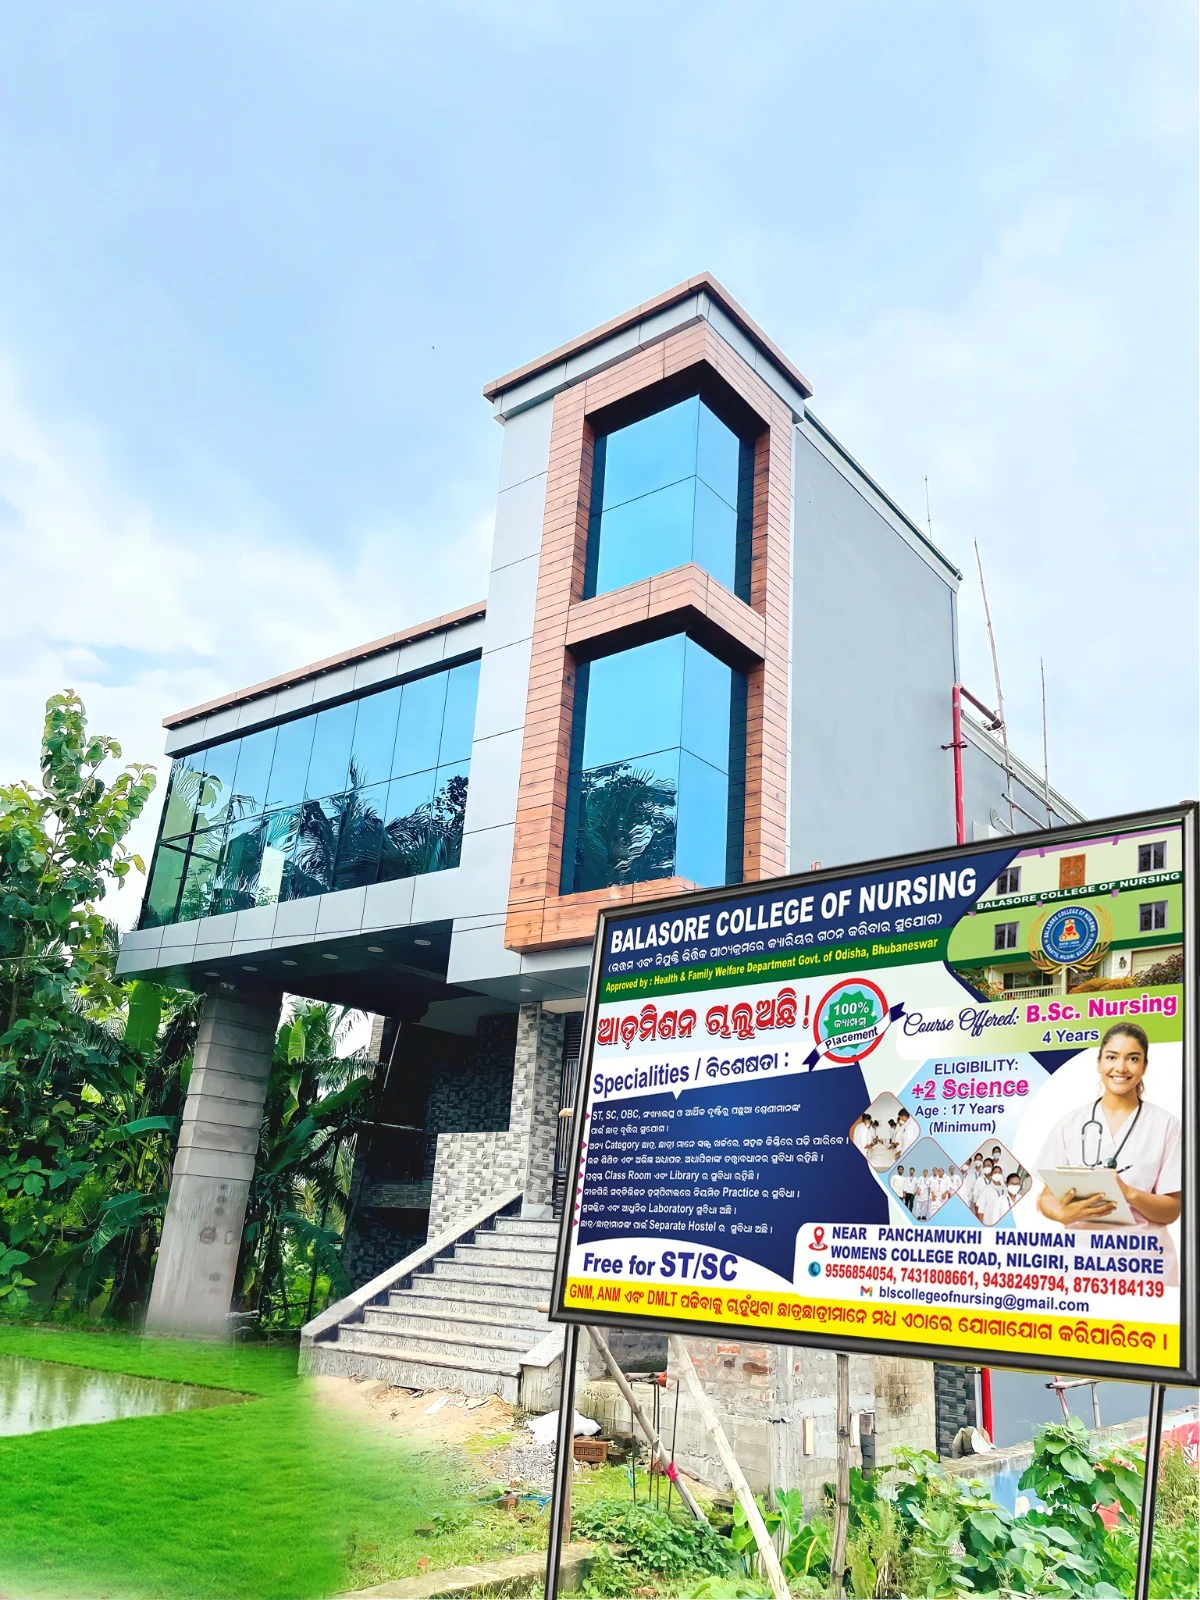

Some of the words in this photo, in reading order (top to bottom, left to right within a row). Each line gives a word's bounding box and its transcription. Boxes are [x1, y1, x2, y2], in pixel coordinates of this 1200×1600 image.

[976, 894, 1036, 910] BALASORE
[1040, 885, 1095, 900] COLLEGE
[1100, 882, 1116, 891] OF
[1119, 872, 1180, 888] NURSING
[611, 914, 710, 954] BALASORE
[716, 896, 814, 937] COLLEGE
[821, 889, 852, 919] OF
[859, 867, 976, 914] NURSING
[606, 977, 638, 993] Approved
[639, 976, 648, 990] by
[654, 972, 678, 985] Health
[680, 971, 686, 982] &
[687, 968, 713, 981] Family
[715, 962, 745, 977] Welfare
[746, 958, 796, 974] Department
[798, 954, 821, 965] Govt.
[823, 951, 833, 962] of
[835, 947, 870, 962] Odisha,
[872, 938, 939, 956] Bhubaneswar
[833, 1001, 869, 1016] 100%
[903, 1012, 954, 1037] Course
[958, 1007, 1020, 1037] Offered:
[1026, 1002, 1081, 1024] B.Sc.
[1088, 994, 1178, 1018] Nursing
[824, 1026, 878, 1049] Placement
[1042, 1031, 1052, 1044] 4
[1056, 1028, 1100, 1043] Years
[934, 1059, 1019, 1075] ELIGIBILITY:
[592, 1063, 690, 1098] Specialities
[911, 1080, 936, 1100] +2
[942, 1077, 1029, 1098] Science
[592, 1110, 604, 1121] ST,
[605, 1110, 619, 1120] SC,
[620, 1109, 641, 1119] OBC,
[914, 1105, 939, 1118] Age
[951, 1104, 965, 1115] 17
[968, 1103, 1005, 1115] Years
[928, 1120, 997, 1135] (Minimum)
[605, 1140, 640, 1151] Category
[604, 1170, 626, 1180] Class
[628, 1170, 651, 1180] Room
[669, 1170, 699, 1182] Library
[722, 1187, 759, 1198] Practice
[648, 1203, 694, 1216] Laboratory
[649, 1219, 686, 1232] Separate
[688, 1221, 716, 1232] Hostel
[832, 1226, 867, 1240] NEAR
[878, 1228, 982, 1244] PANCHAMUKHI
[995, 1231, 1075, 1248] HANUMAN
[1090, 1234, 1164, 1254] MANDIR,
[583, 1252, 623, 1274] Free
[628, 1255, 656, 1276] for
[660, 1251, 738, 1282] ST/SC
[831, 1246, 887, 1261] WOMENS
[891, 1248, 954, 1264] COLLEGE
[958, 1250, 1002, 1269] ROAD,
[1006, 1253, 1069, 1272] NILGIRI,
[1074, 1255, 1164, 1274] BALASORE
[825, 1263, 897, 1284] 9556854054,
[900, 1267, 979, 1289] 7431808661,
[983, 1271, 1069, 1295] 9438249794,
[1073, 1276, 1164, 1298] 8763184139
[569, 1283, 595, 1303] GNM,
[597, 1287, 621, 1302] ANM
[647, 1290, 677, 1307] DMLT
[879, 1286, 1089, 1312] blscollegeofnursing@gmail.com
